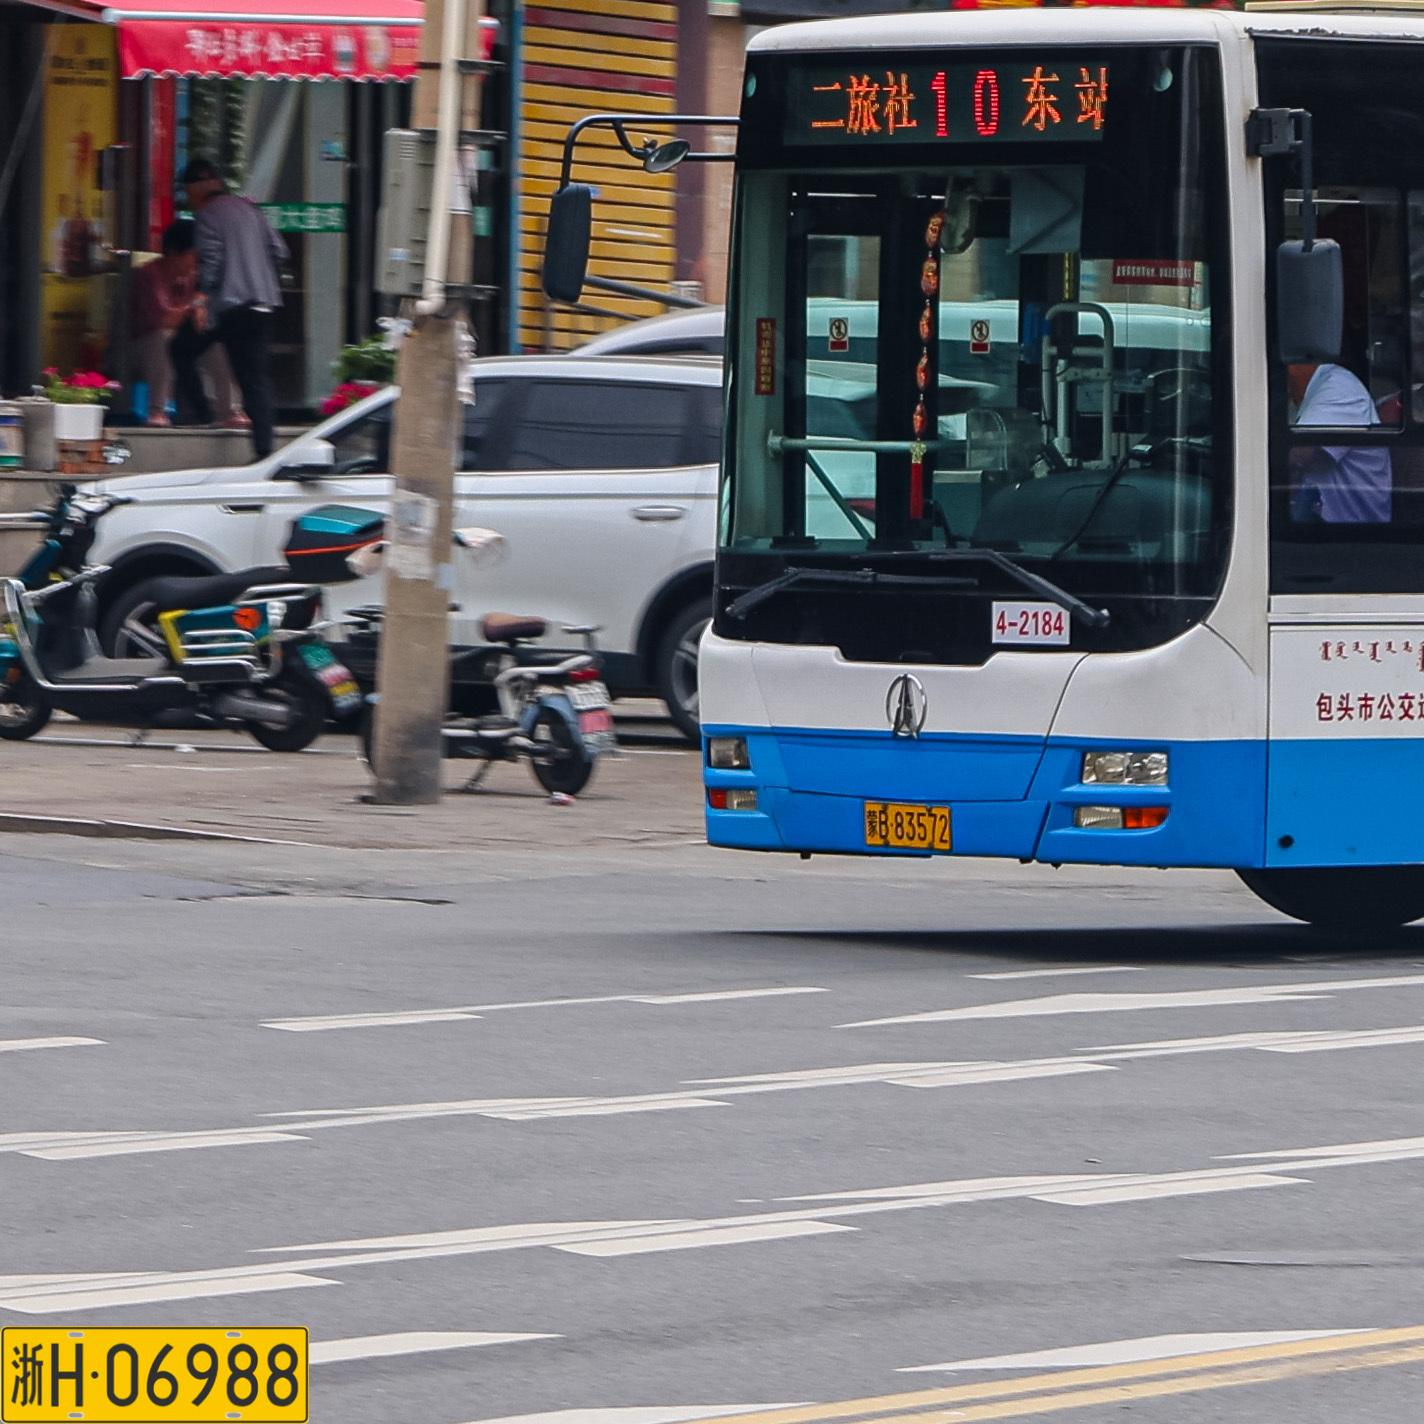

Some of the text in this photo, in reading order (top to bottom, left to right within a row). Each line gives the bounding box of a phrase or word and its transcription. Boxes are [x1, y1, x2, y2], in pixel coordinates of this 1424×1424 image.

[811, 71, 917, 135] 二旅社
[996, 610, 1065, 636] 4-2184
